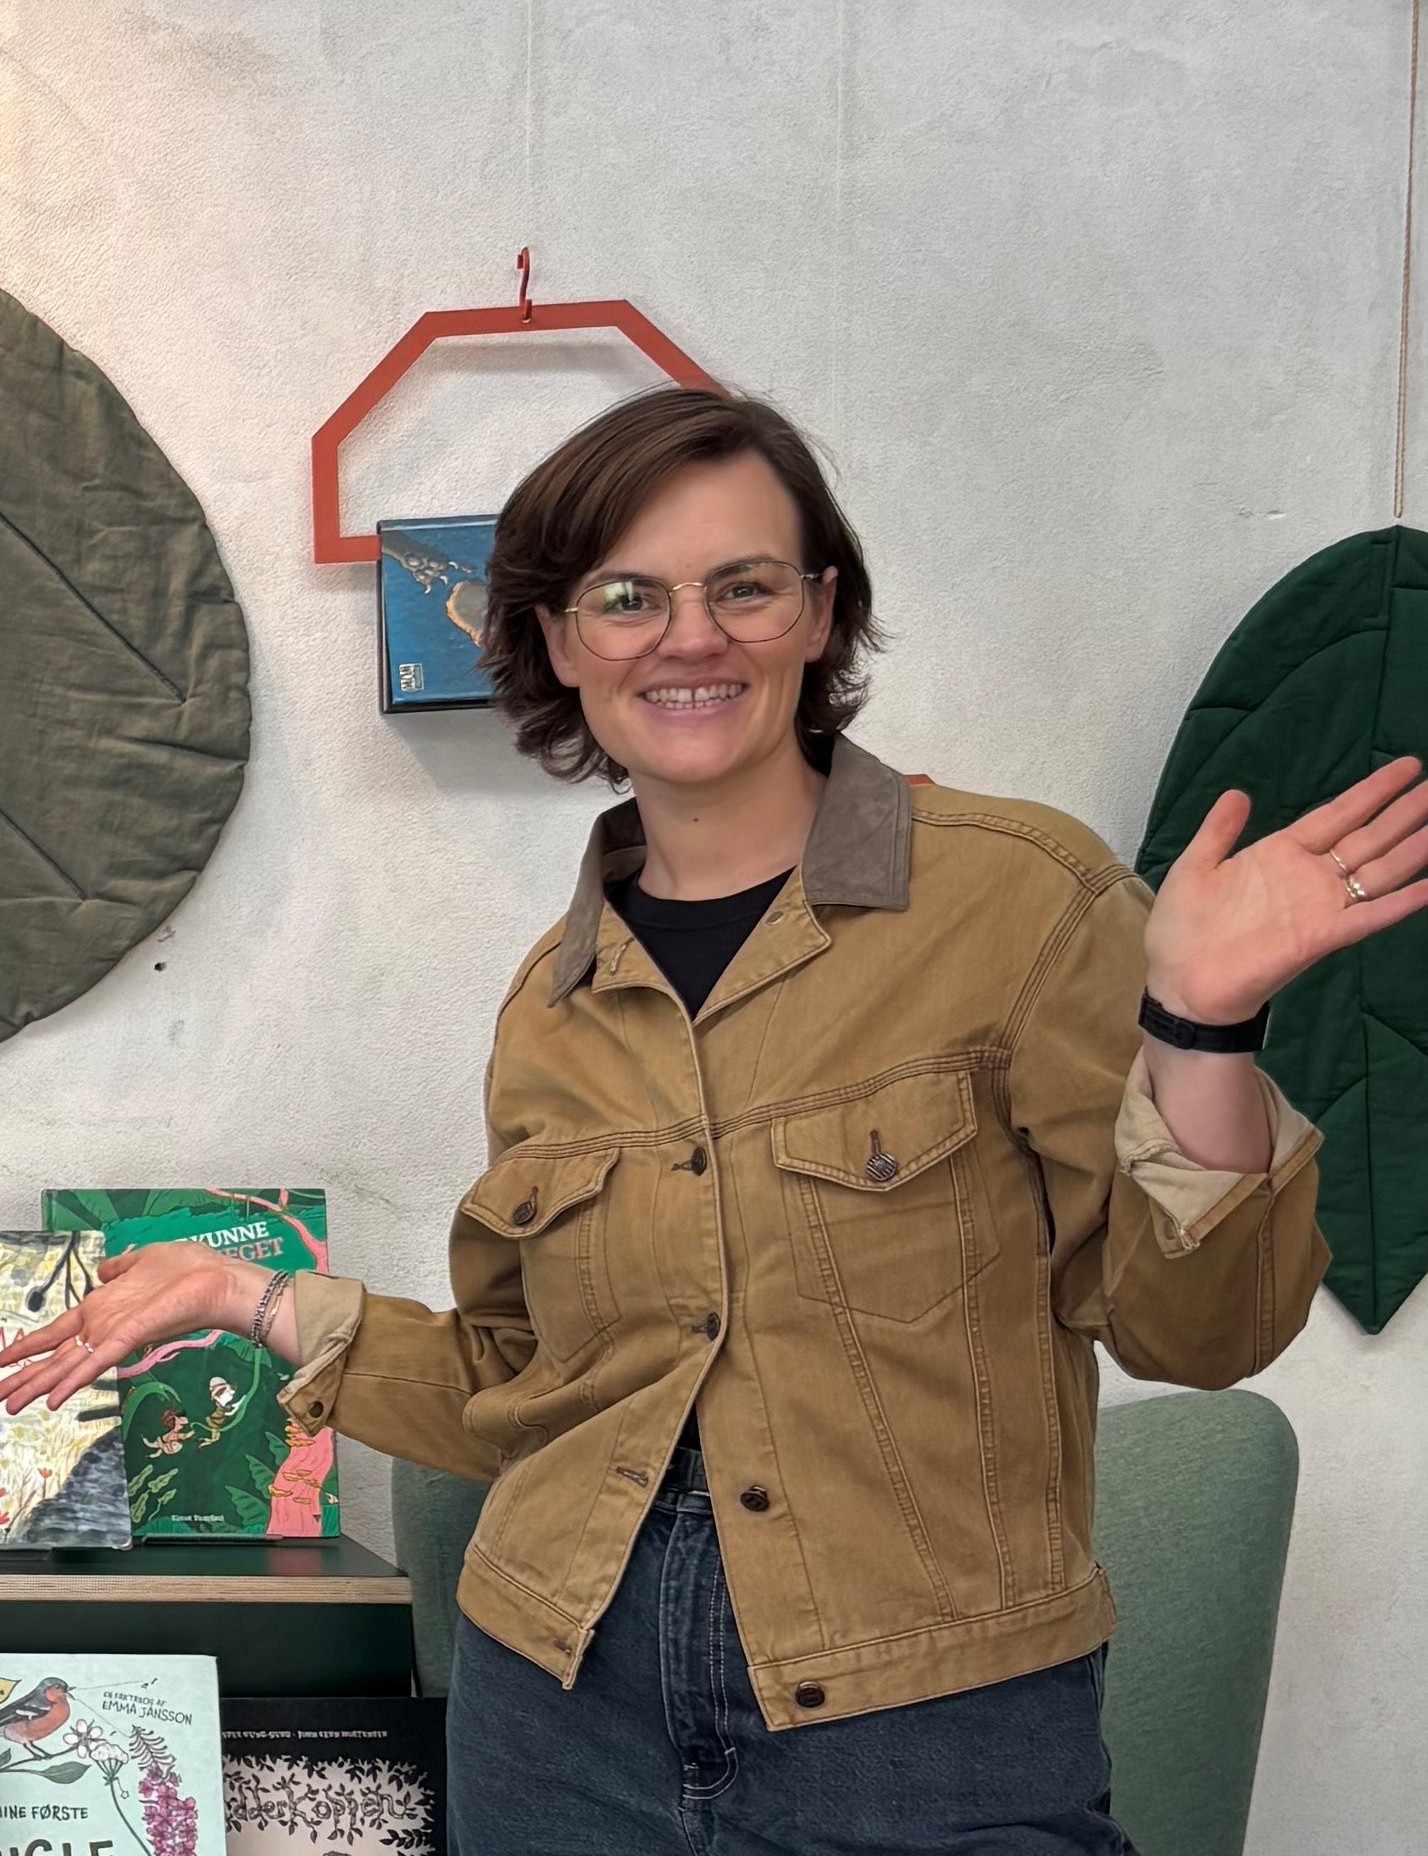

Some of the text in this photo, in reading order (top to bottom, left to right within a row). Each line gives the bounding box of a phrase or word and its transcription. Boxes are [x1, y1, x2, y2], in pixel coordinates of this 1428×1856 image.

[102, 1700, 193, 1726] EMMA JANSSON
[31, 1803, 89, 1823] FØRSTE
